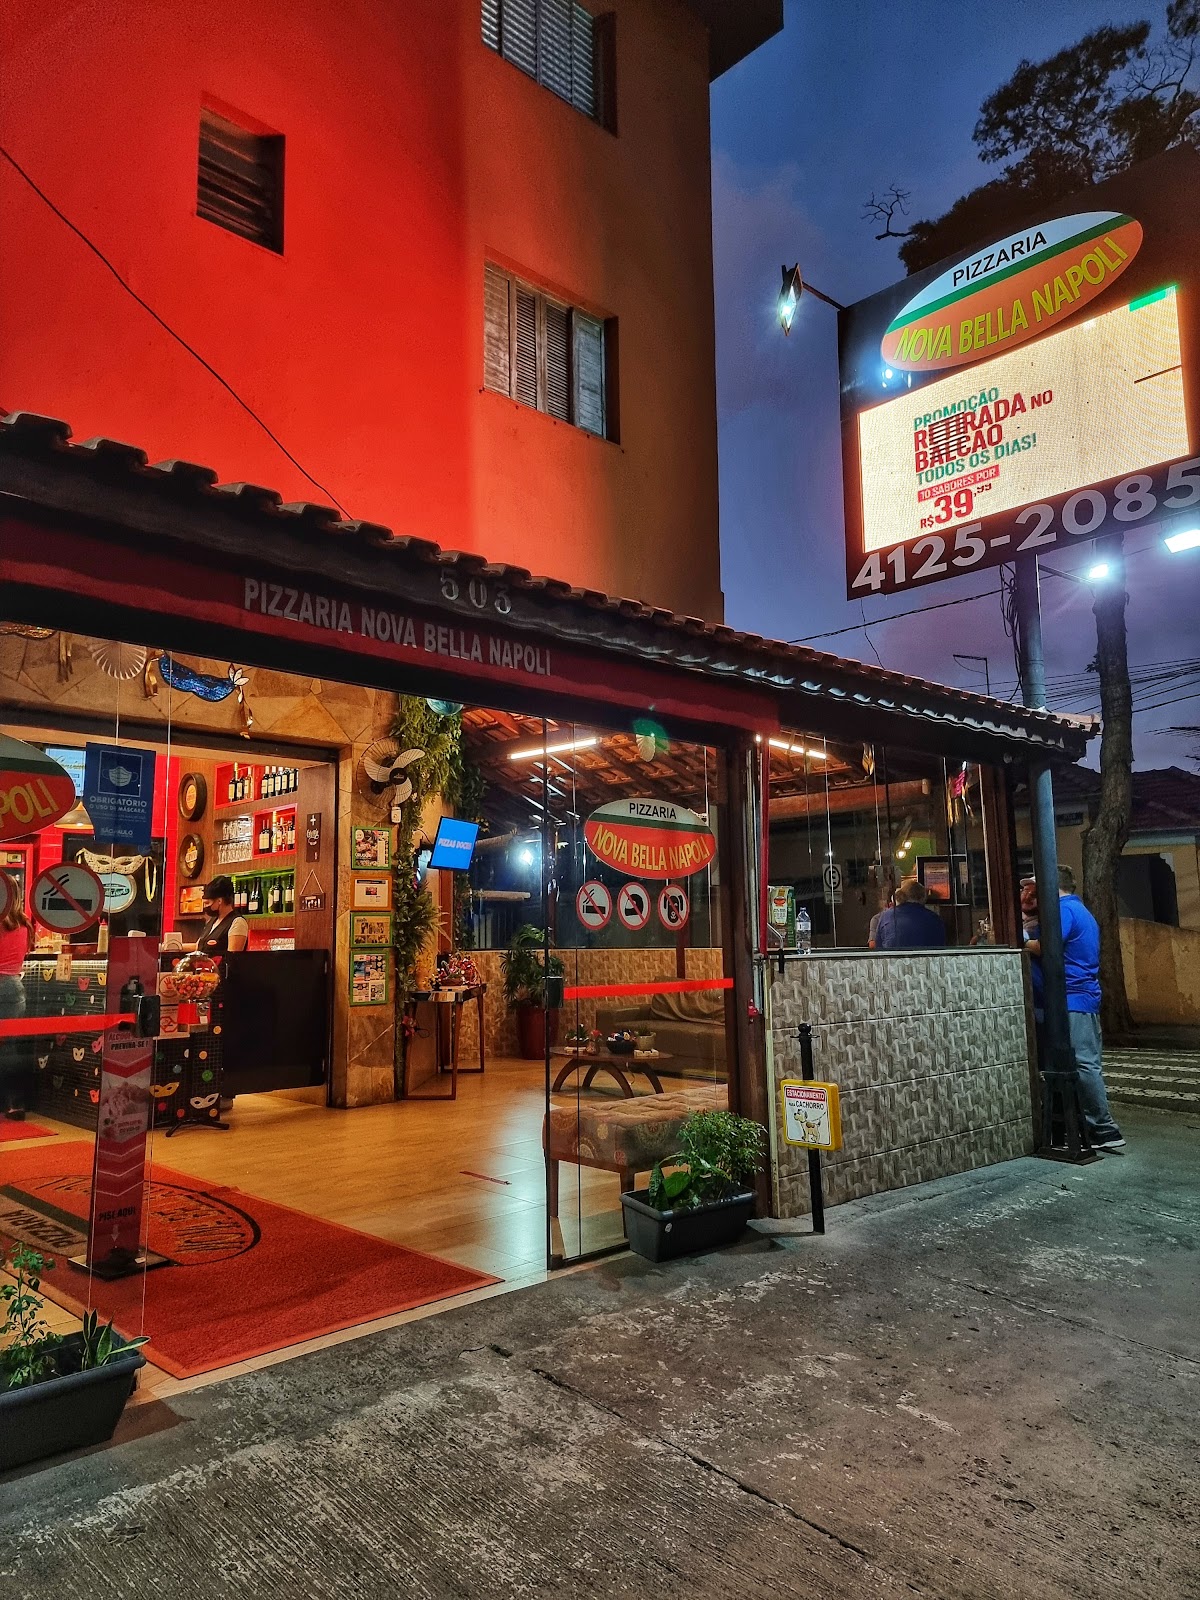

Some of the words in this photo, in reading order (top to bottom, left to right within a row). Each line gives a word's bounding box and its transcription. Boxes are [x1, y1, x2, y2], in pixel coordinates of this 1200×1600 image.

[953, 231, 1047, 287] PIZZARIA
[893, 325, 953, 362] NOVA
[958, 299, 1029, 354] BELLA
[1031, 237, 1129, 323] NAPOLI
[914, 387, 999, 431] PROMOÇÃO
[1030, 390, 1053, 410] NO
[917, 458, 965, 485] TODOS
[969, 449, 990, 468] OS
[994, 432, 1037, 460] DIAS!
[932, 477, 975, 496] SABORES
[976, 468, 996, 481] POR
[851, 457, 1200, 591] 4125-2085
[244, 577, 353, 634] PIZZARIA
[361, 606, 417, 649] NOVA
[424, 622, 483, 663] BELLA
[489, 635, 550, 676] NAPOLI
[90, 796, 147, 808] OBRIGATÓRIO
[629, 802, 677, 819] PIZZARIA
[592, 824, 628, 865] NOVA
[631, 842, 667, 871] BELLA
[668, 836, 710, 870] NAPOLI
[786, 1089, 824, 1100] ESTACIONAMENTO
[796, 1100, 824, 1110] CACHORRO
